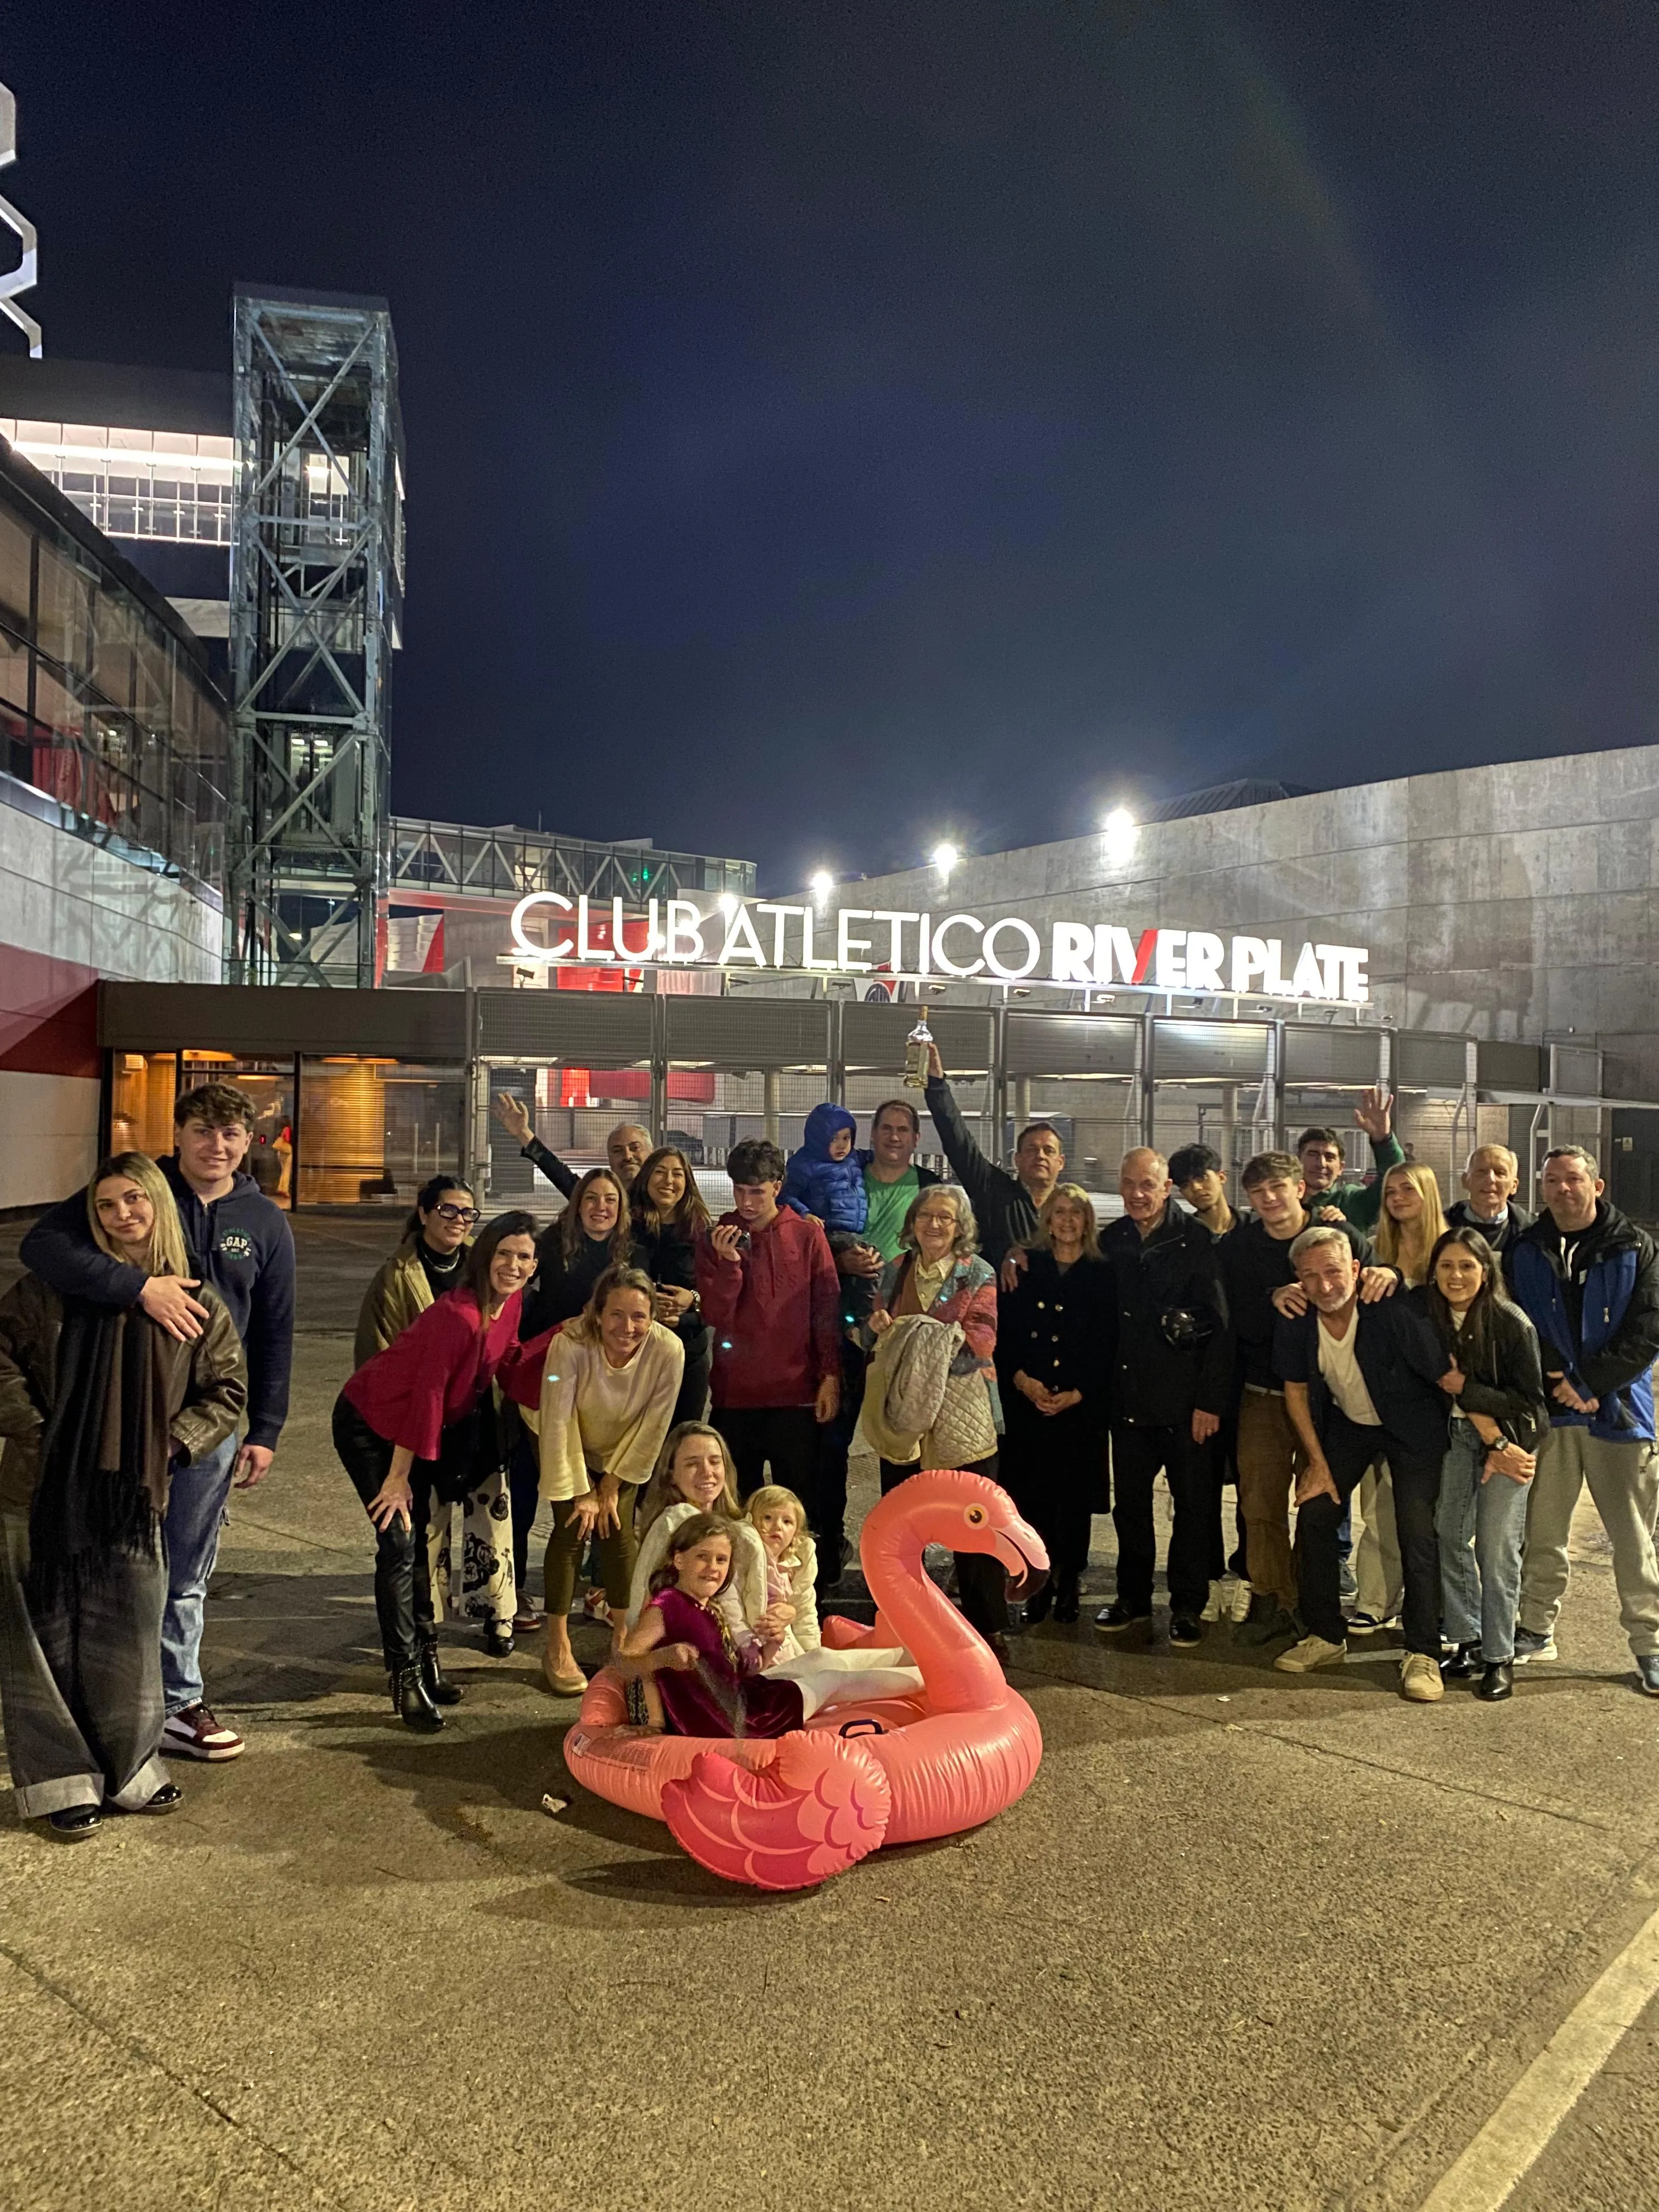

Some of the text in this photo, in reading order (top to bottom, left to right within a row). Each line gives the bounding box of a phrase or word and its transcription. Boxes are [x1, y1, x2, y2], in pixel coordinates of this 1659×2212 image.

[511, 891, 1369, 1001] CLUB ATLETICO RIVER PLATE
[227, 1237, 247, 1248] GAP
